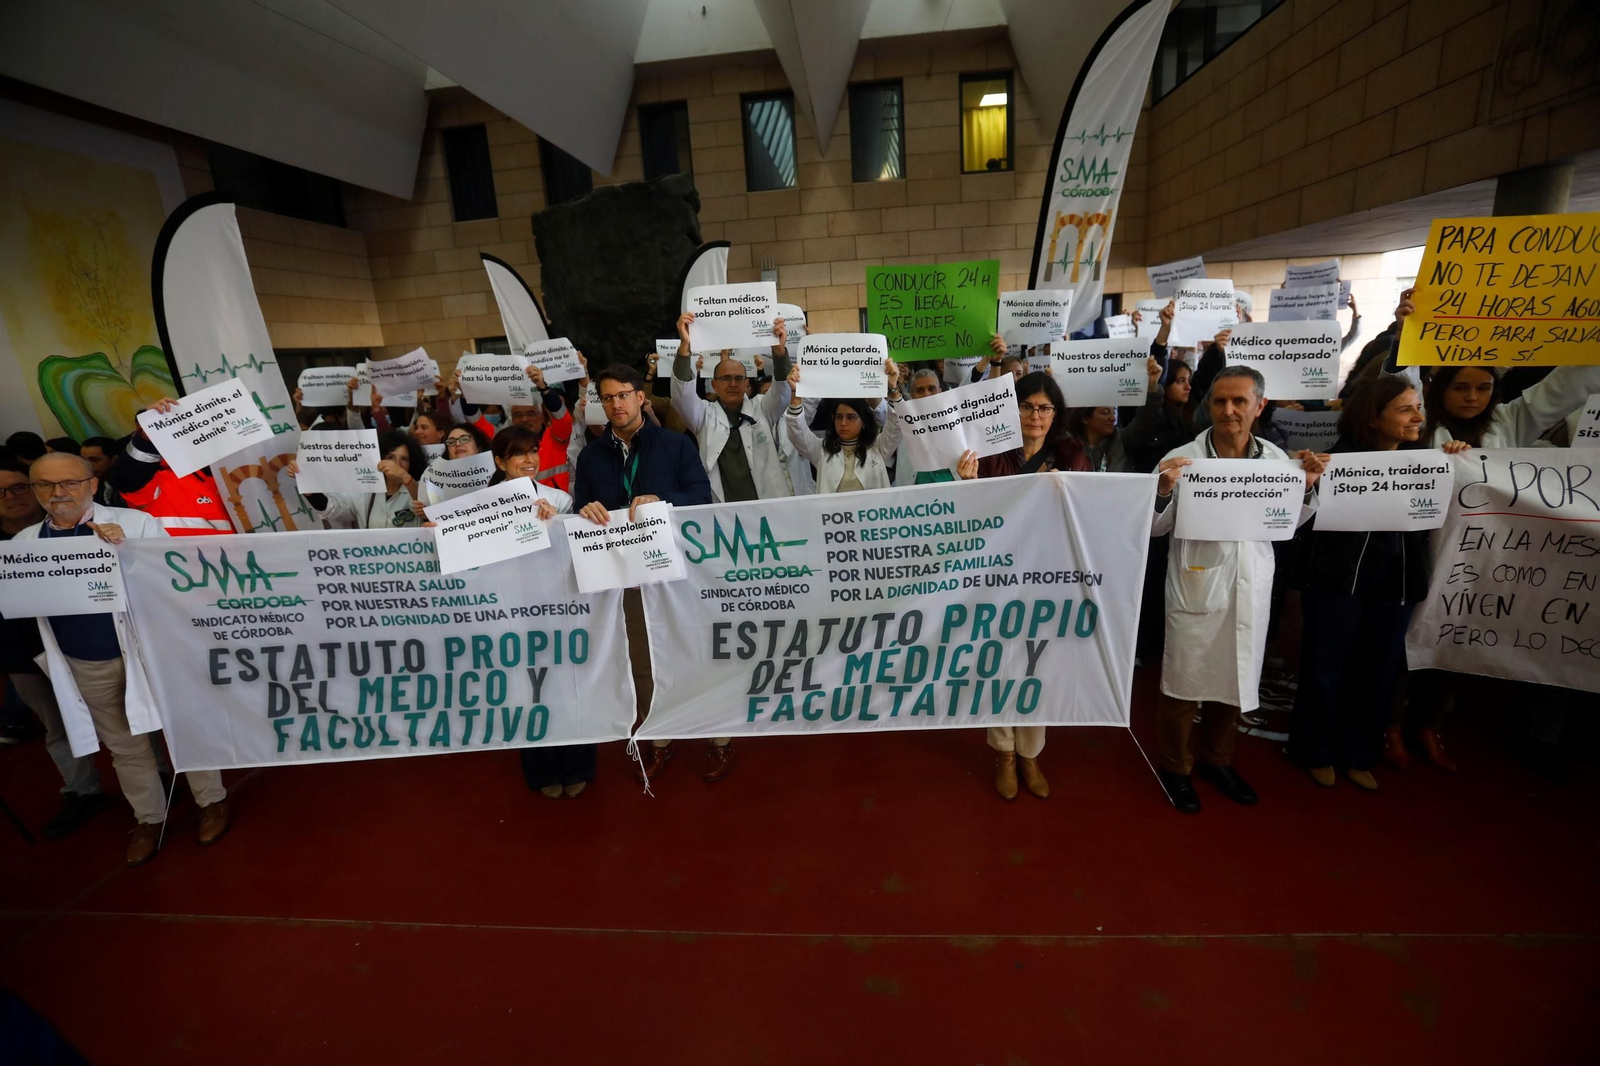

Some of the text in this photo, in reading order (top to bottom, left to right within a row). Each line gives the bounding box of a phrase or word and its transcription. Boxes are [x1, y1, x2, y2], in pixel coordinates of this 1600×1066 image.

[1060, 156, 1118, 185] SMA
[1436, 225, 1497, 255] PARA
[956, 266, 979, 288] 24
[1429, 260, 1463, 286] NO
[1474, 262, 1506, 287] TE
[694, 294, 769, 306] “Faltan médicos,
[694, 309, 727, 319] sobran
[728, 305, 770, 318] políticos”
[879, 294, 903, 310] ES
[1431, 289, 1557, 318] 24 HORAS
[882, 314, 957, 332] ATENDER
[1419, 321, 1480, 342] PERO
[1489, 325, 1536, 342] PARA
[803, 344, 881, 356] ¡Mónica petarda,
[886, 334, 947, 351] ACIENTES
[1274, 333, 1337, 348] quemado,
[801, 357, 818, 366] haz
[819, 357, 829, 366] tú
[831, 356, 840, 366] la
[842, 356, 882, 368] guardia!
[1051, 350, 1147, 361] “Nuestros derechos
[1227, 348, 1338, 362] sistema colapsado”
[1067, 363, 1131, 374] son tu salud”
[148, 410, 194, 432] “Mónica
[194, 396, 232, 415] dimite,
[233, 388, 242, 399] el
[898, 388, 1014, 425] “Queremos dignidad,
[172, 406, 236, 440] médico no te
[912, 403, 1005, 437] no temporalidad”
[193, 421, 229, 446] admite”
[1182, 473, 1303, 486] “Menos explotación,
[1330, 463, 1450, 481] ¡Mónica, traidora!
[1193, 488, 1289, 501] más protección”
[1333, 479, 1436, 496] ¡Stop 24 horas!
[435, 512, 454, 522] “De
[455, 503, 490, 519] España
[499, 492, 530, 506] Berlín,
[821, 499, 955, 526] POR FORMACIÓN
[442, 504, 533, 536] porque aquí no hay
[467, 520, 513, 542] porvenir”
[568, 517, 667, 540] “Menos explotación,
[824, 515, 1005, 544] POR RESPONSABILIDAD
[308, 538, 434, 562] POR FORMACIÓN
[582, 530, 658, 553] más protección”
[681, 513, 809, 567] SMA
[827, 537, 986, 565] POR NUESTRA SALUD
[1459, 525, 1532, 553] EN LA
[52, 549, 115, 564] quemado,
[829, 553, 1014, 583] POR NUESTRAS FAMILIAS
[48, 563, 117, 578] colapsado”
[164, 546, 299, 598] SMA
[313, 564, 346, 577] POR
[1446, 562, 1597, 592] ES COMO EN
[317, 578, 466, 595] POR NUESTRA SALUD
[700, 582, 811, 600] SINDICATO MÉDICO
[830, 570, 1103, 602] POR LA DIGNIDAD DE UNA PROFESIÓN
[321, 592, 498, 612] POR NUESTRAS FAMILIAS
[721, 599, 796, 613] DE CÓRDOBA
[1541, 598, 1590, 625] EN
[191, 611, 305, 628] SINDICATO MÉDICO
[326, 602, 591, 630] POR LA DIGNIDAD DE UNA PROFESIÓN
[213, 624, 293, 642] DE CÓRDOBA
[712, 598, 1099, 661] ESTATUTO PROPIO
[1436, 622, 1547, 650] PERO LO
[209, 628, 589, 686] ESTATUTO PROPIO
[746, 638, 1050, 695] DEL MÉDICO Y
[267, 666, 549, 718] DEL MÉDICO Y
[746, 677, 1043, 723] FACULTATIVO
[272, 704, 550, 753] FACULTATIVO
